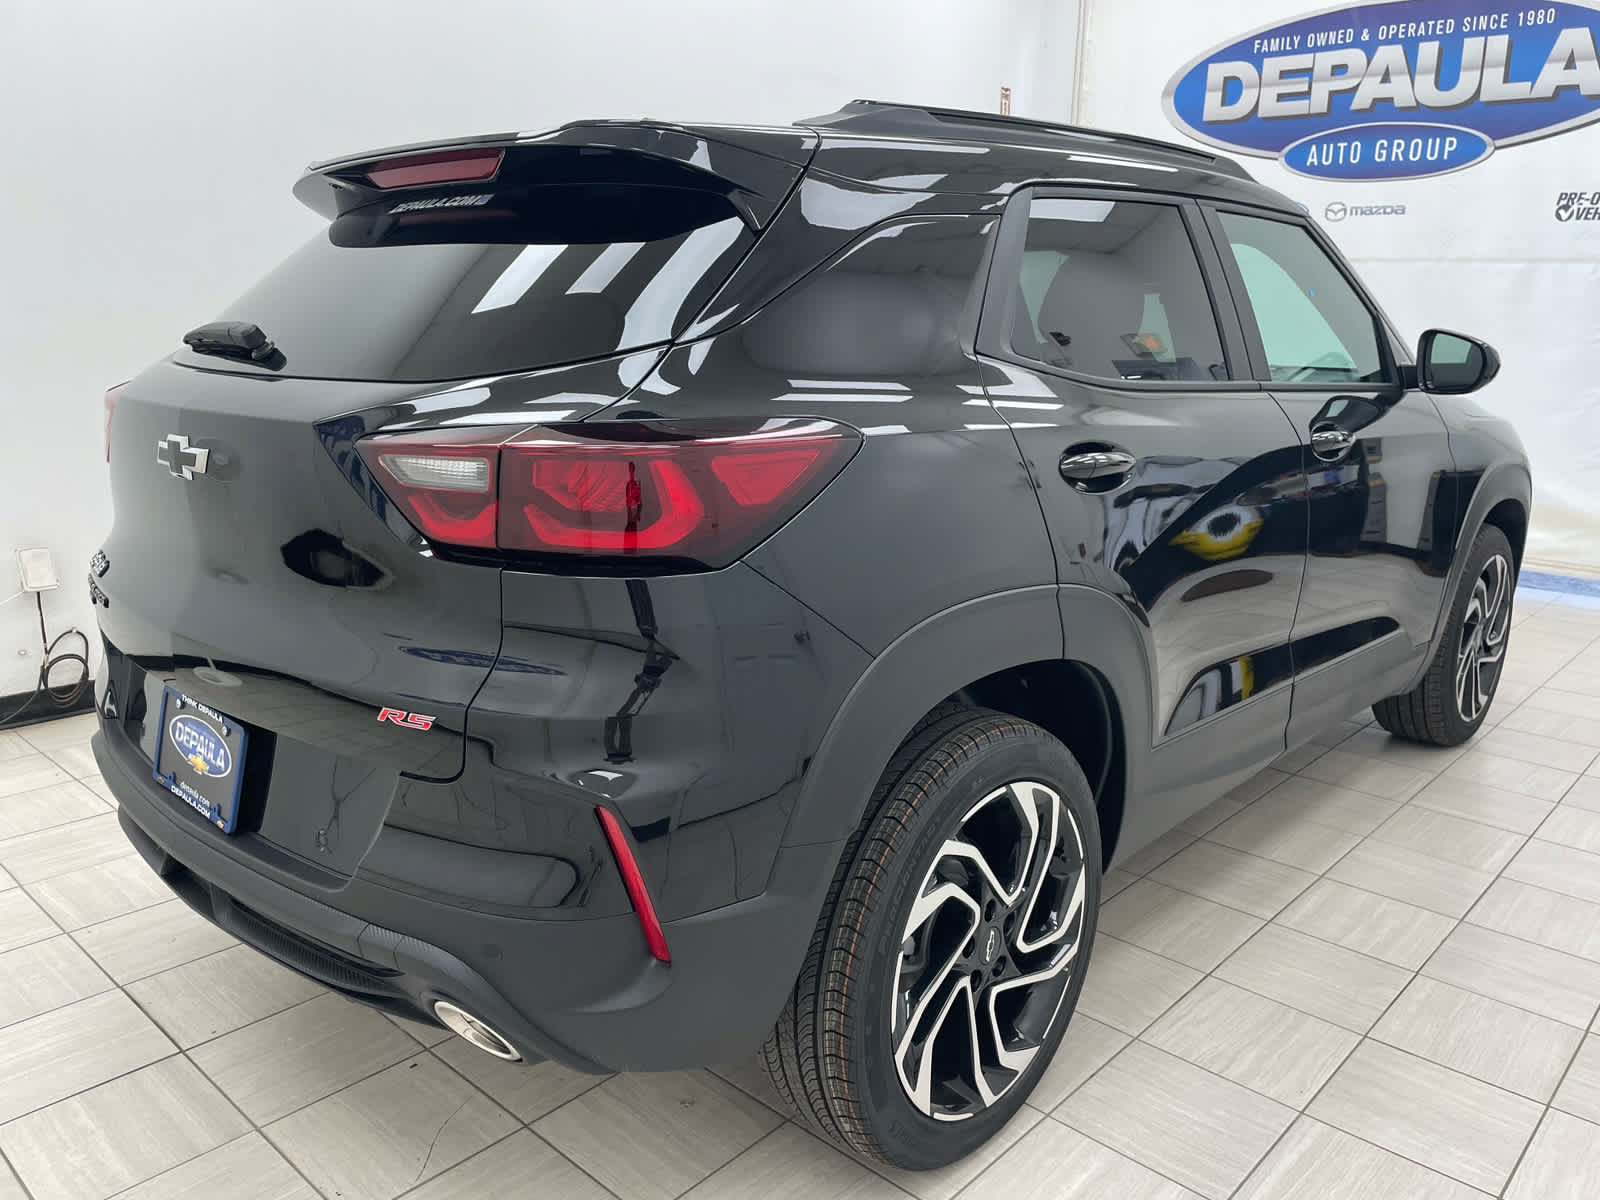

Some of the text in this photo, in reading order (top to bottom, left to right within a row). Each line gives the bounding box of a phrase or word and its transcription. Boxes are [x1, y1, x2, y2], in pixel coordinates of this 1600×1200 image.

[1254, 8, 1556, 54] FAMILY OWNED & OPERATED SINCE 1980
[1202, 27, 1600, 123] DEPAULA
[1306, 137, 1458, 167] AUTO GROUP
[1349, 204, 1407, 217] mazda
[181, 694, 224, 725] THINK DEPAULA
[376, 706, 437, 731] RS
[175, 721, 225, 772] DEPAULA
